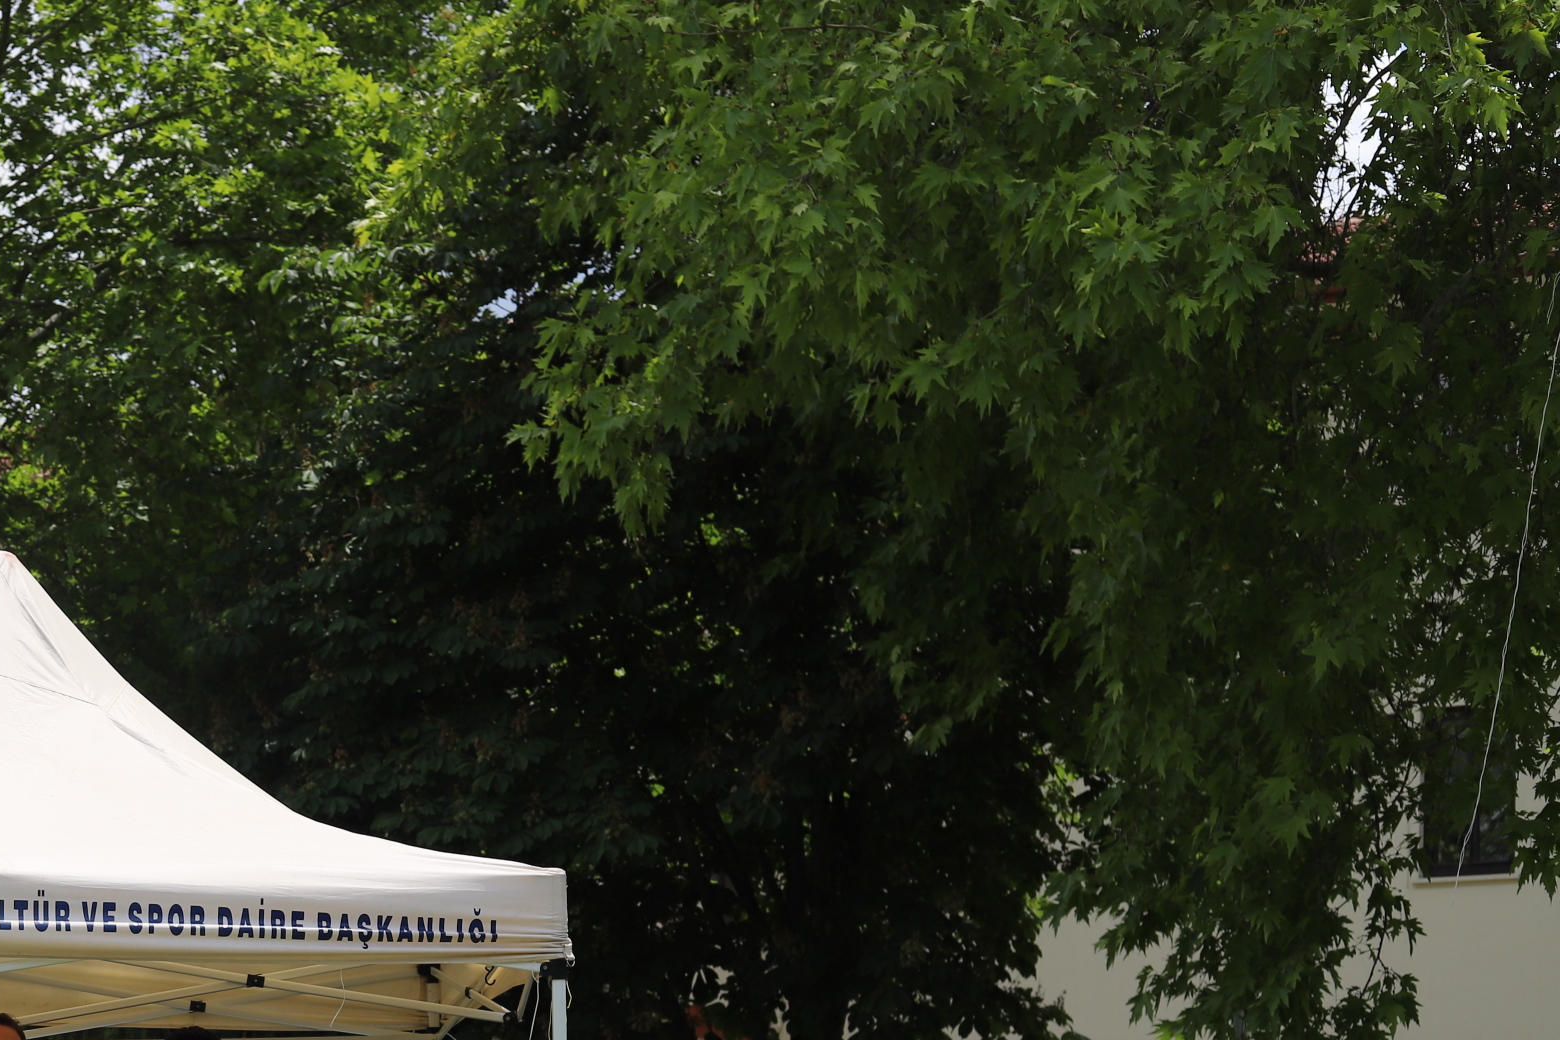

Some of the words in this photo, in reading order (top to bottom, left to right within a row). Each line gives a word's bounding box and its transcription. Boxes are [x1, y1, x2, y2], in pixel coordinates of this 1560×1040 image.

[81, 901, 117, 933] VE
[128, 901, 205, 937] SPOR
[217, 898, 305, 940] DAİRE
[317, 908, 498, 950] BAŞKANLIĞI
